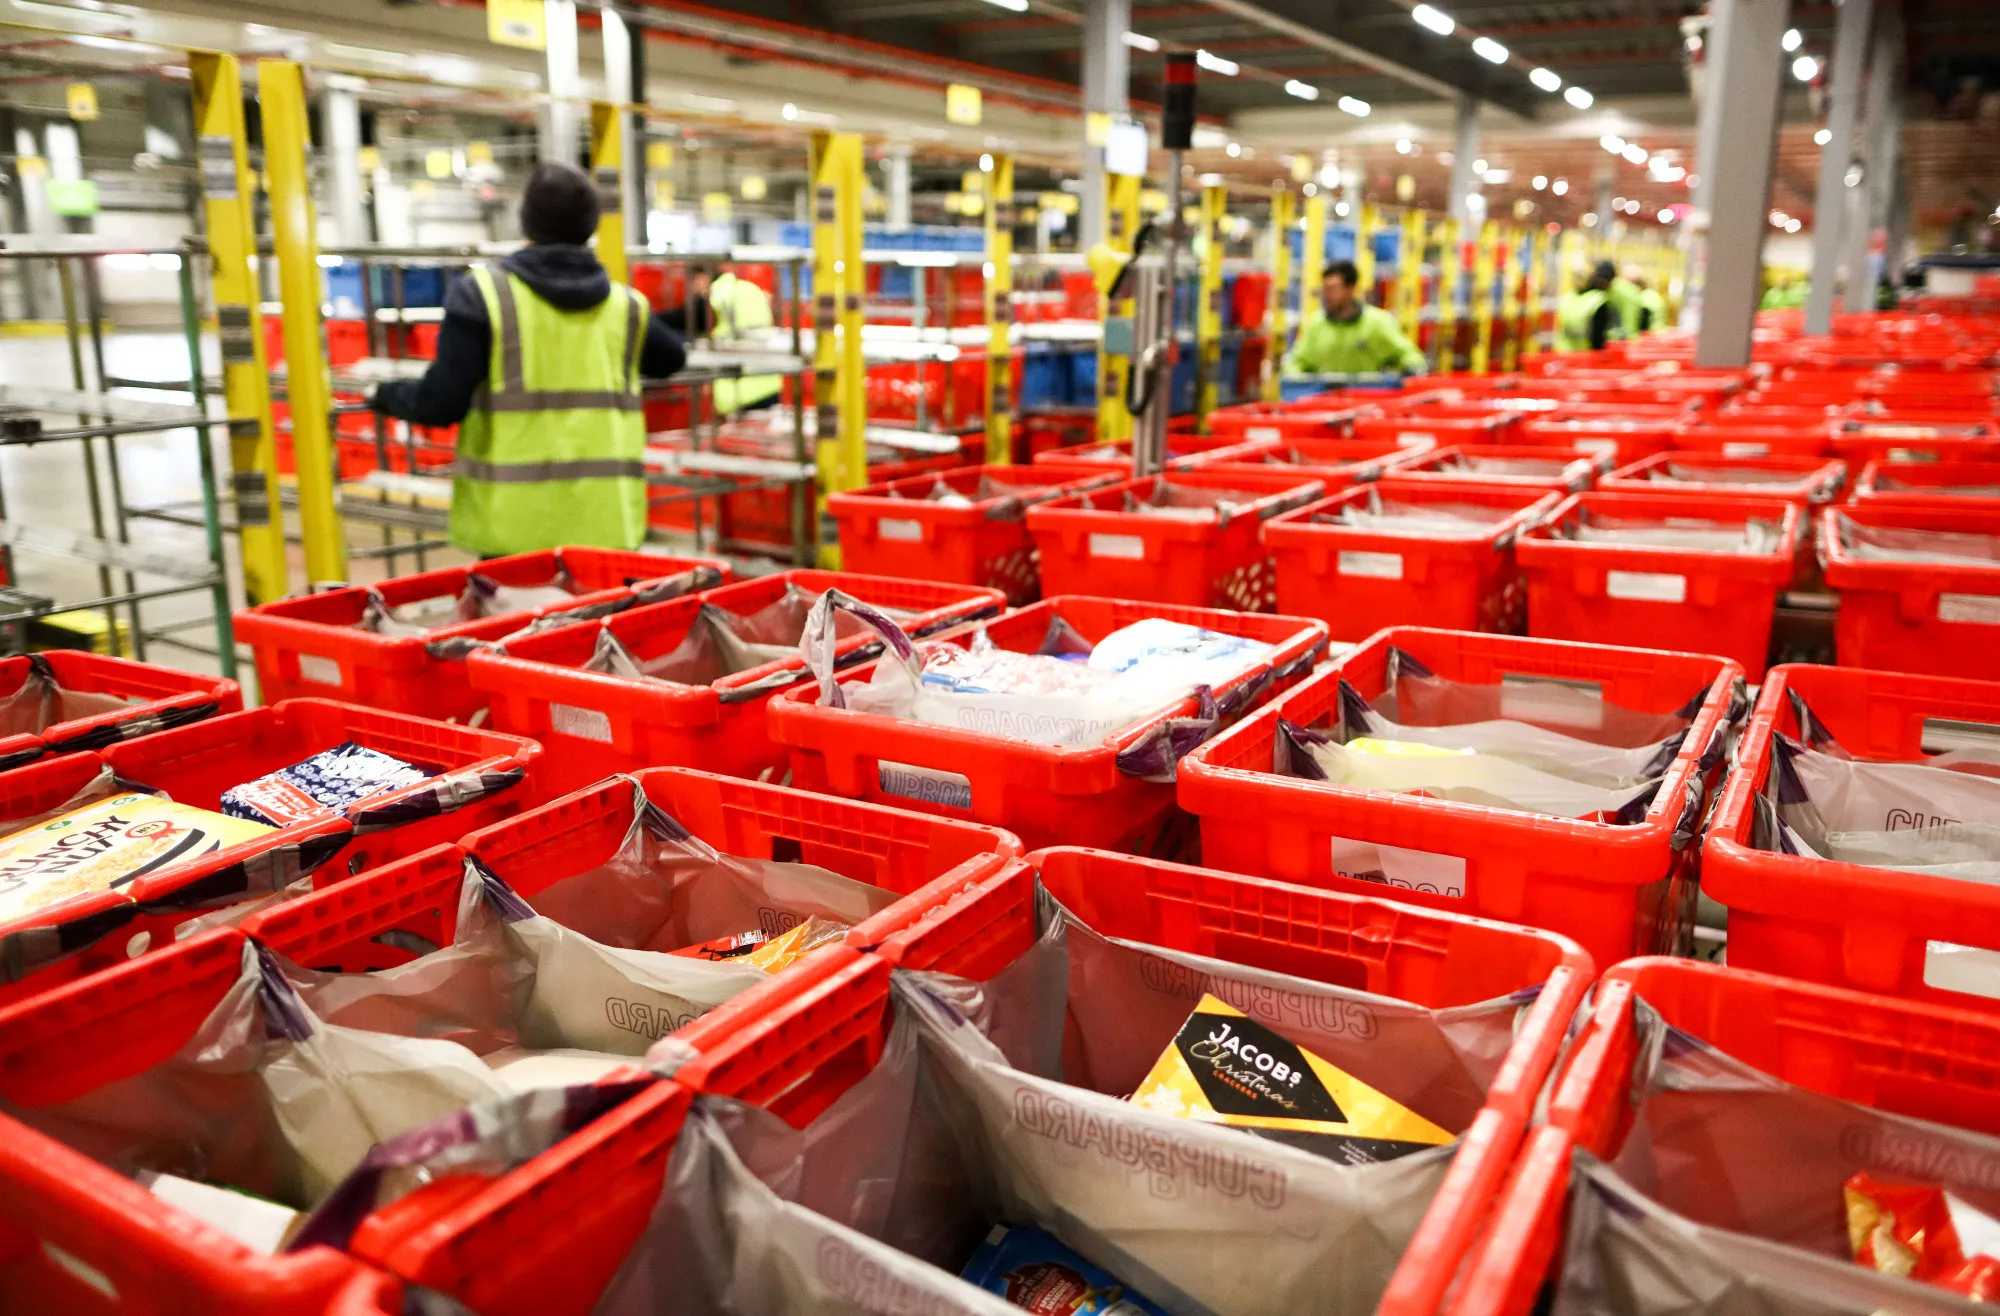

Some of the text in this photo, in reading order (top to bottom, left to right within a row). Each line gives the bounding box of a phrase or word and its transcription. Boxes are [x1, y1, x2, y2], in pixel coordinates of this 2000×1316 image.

[0, 815, 131, 893] RUNCHY
[36, 835, 113, 874] NUT
[1190, 1039, 1299, 1110] Christmas
